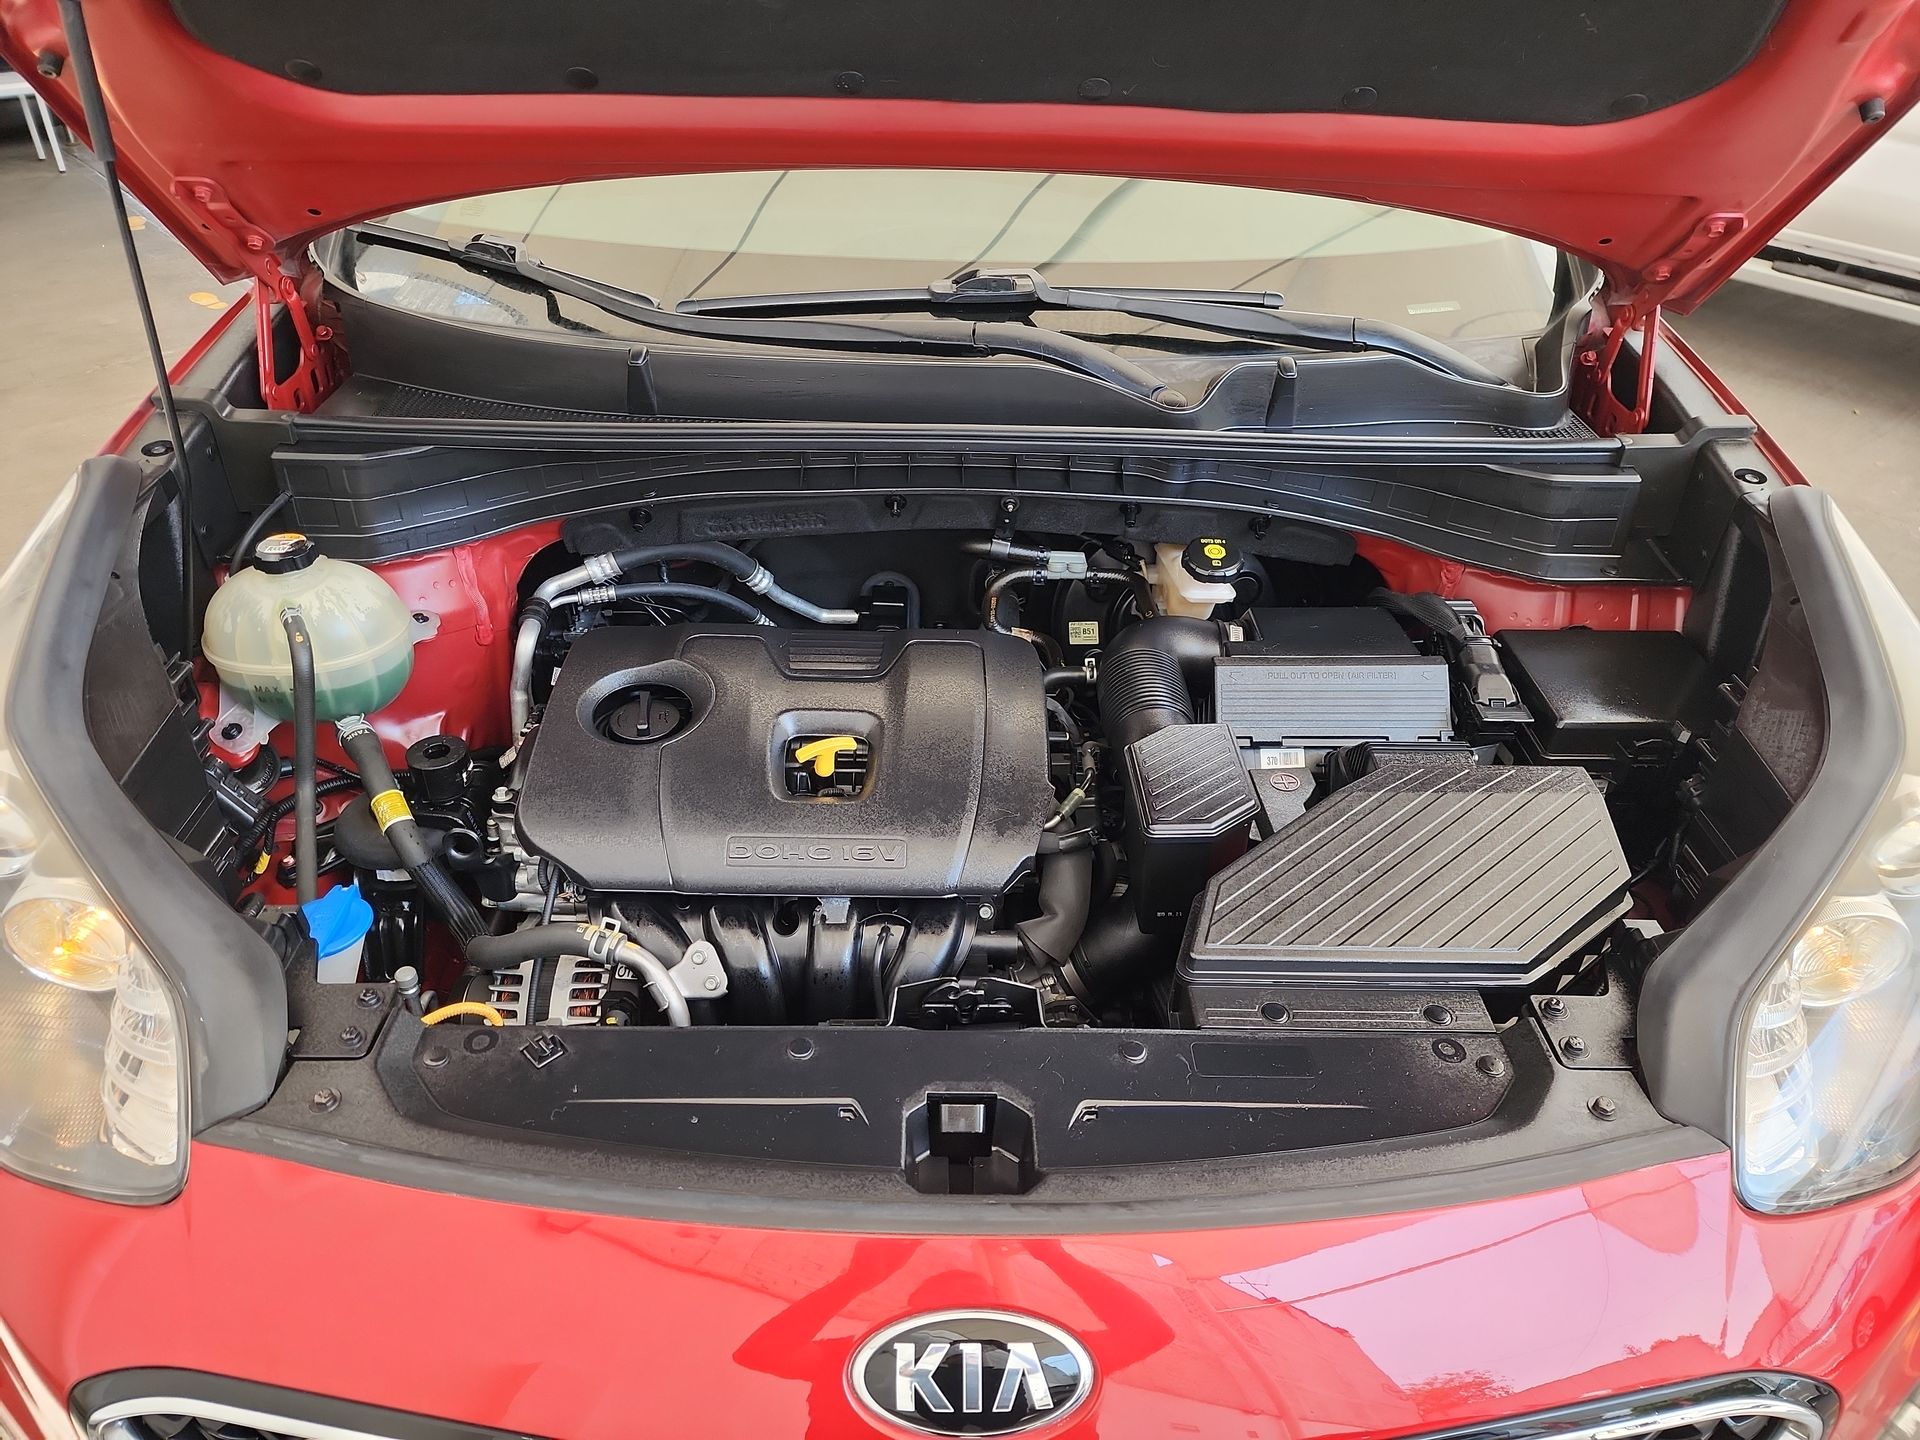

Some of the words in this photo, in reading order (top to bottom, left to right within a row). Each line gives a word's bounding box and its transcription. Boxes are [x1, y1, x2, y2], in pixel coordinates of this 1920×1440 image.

[1267, 671, 1289, 680] PULL
[1290, 671, 1308, 680] OUT
[1309, 671, 1320, 680] TO
[1321, 671, 1344, 680] OPEN
[254, 684, 280, 695] MAX
[346, 728, 370, 742] TANK
[728, 843, 832, 861] DOHC
[842, 844, 904, 863] 16V
[894, 1343, 1054, 1412] KIA
